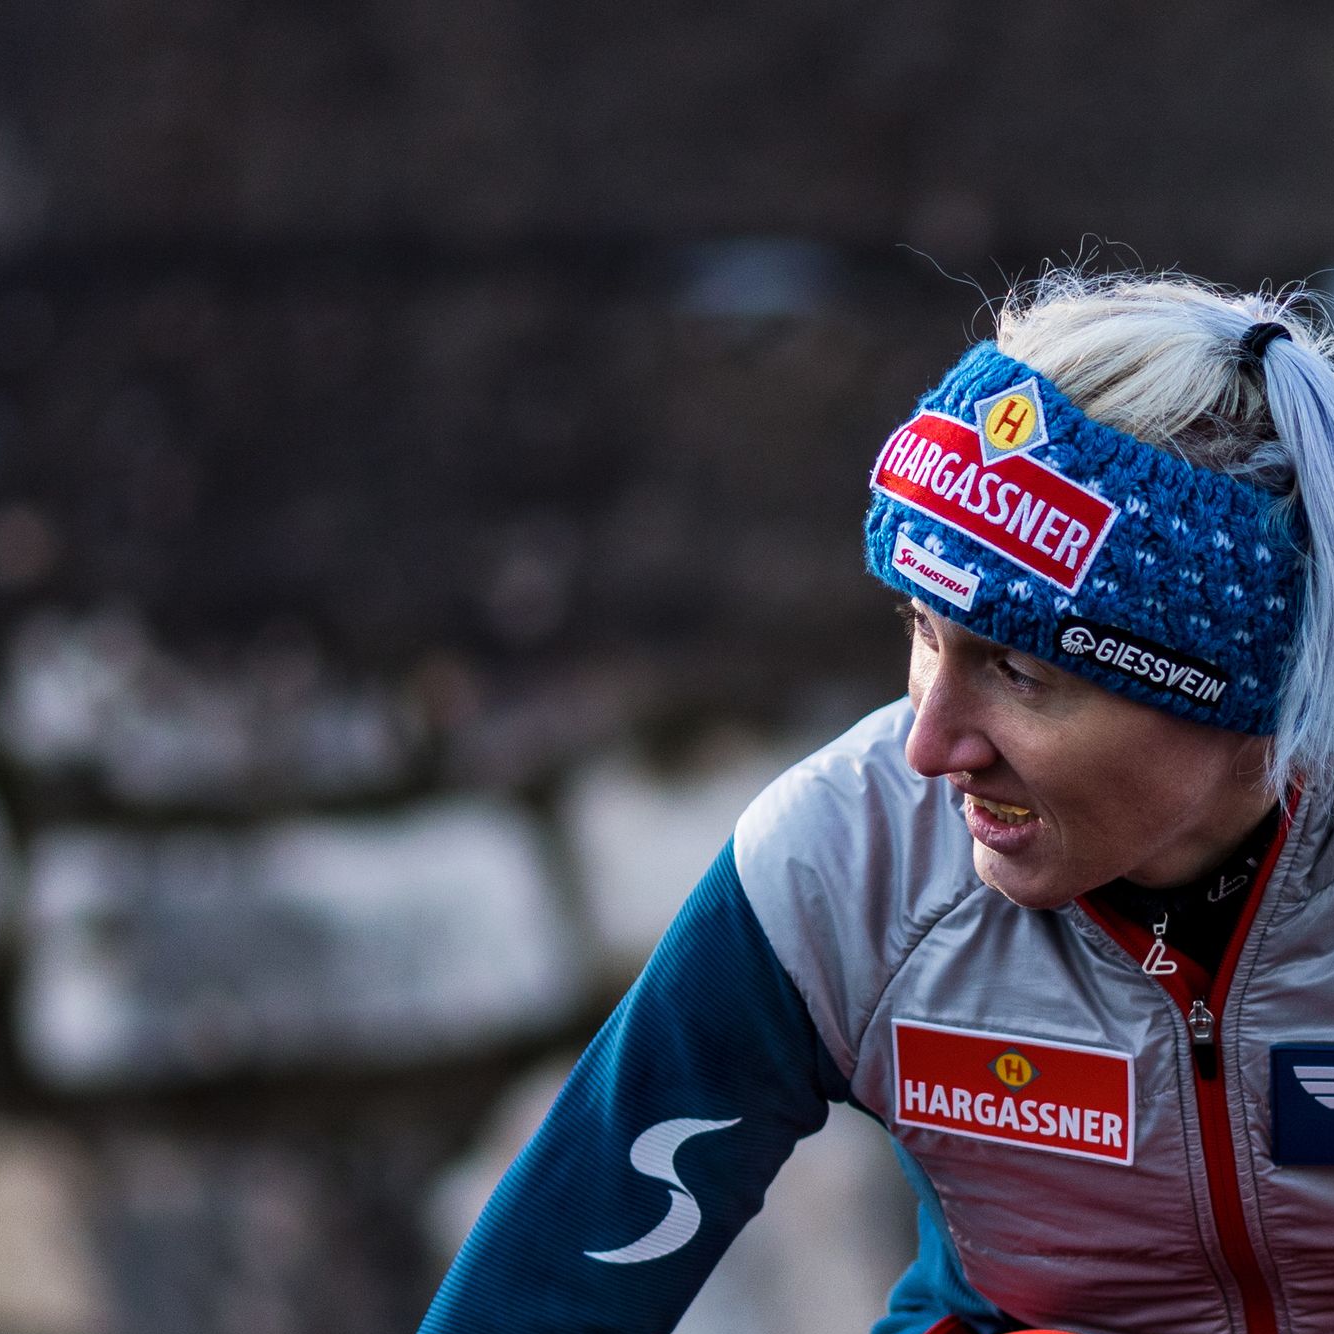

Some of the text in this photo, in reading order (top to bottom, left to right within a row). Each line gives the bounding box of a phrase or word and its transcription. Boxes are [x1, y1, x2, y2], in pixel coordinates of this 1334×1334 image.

[884, 430, 1091, 570] HARGASSNER
[895, 548, 969, 597] SKI AUSTRIA
[904, 1079, 1123, 1148] HARGASSNER
